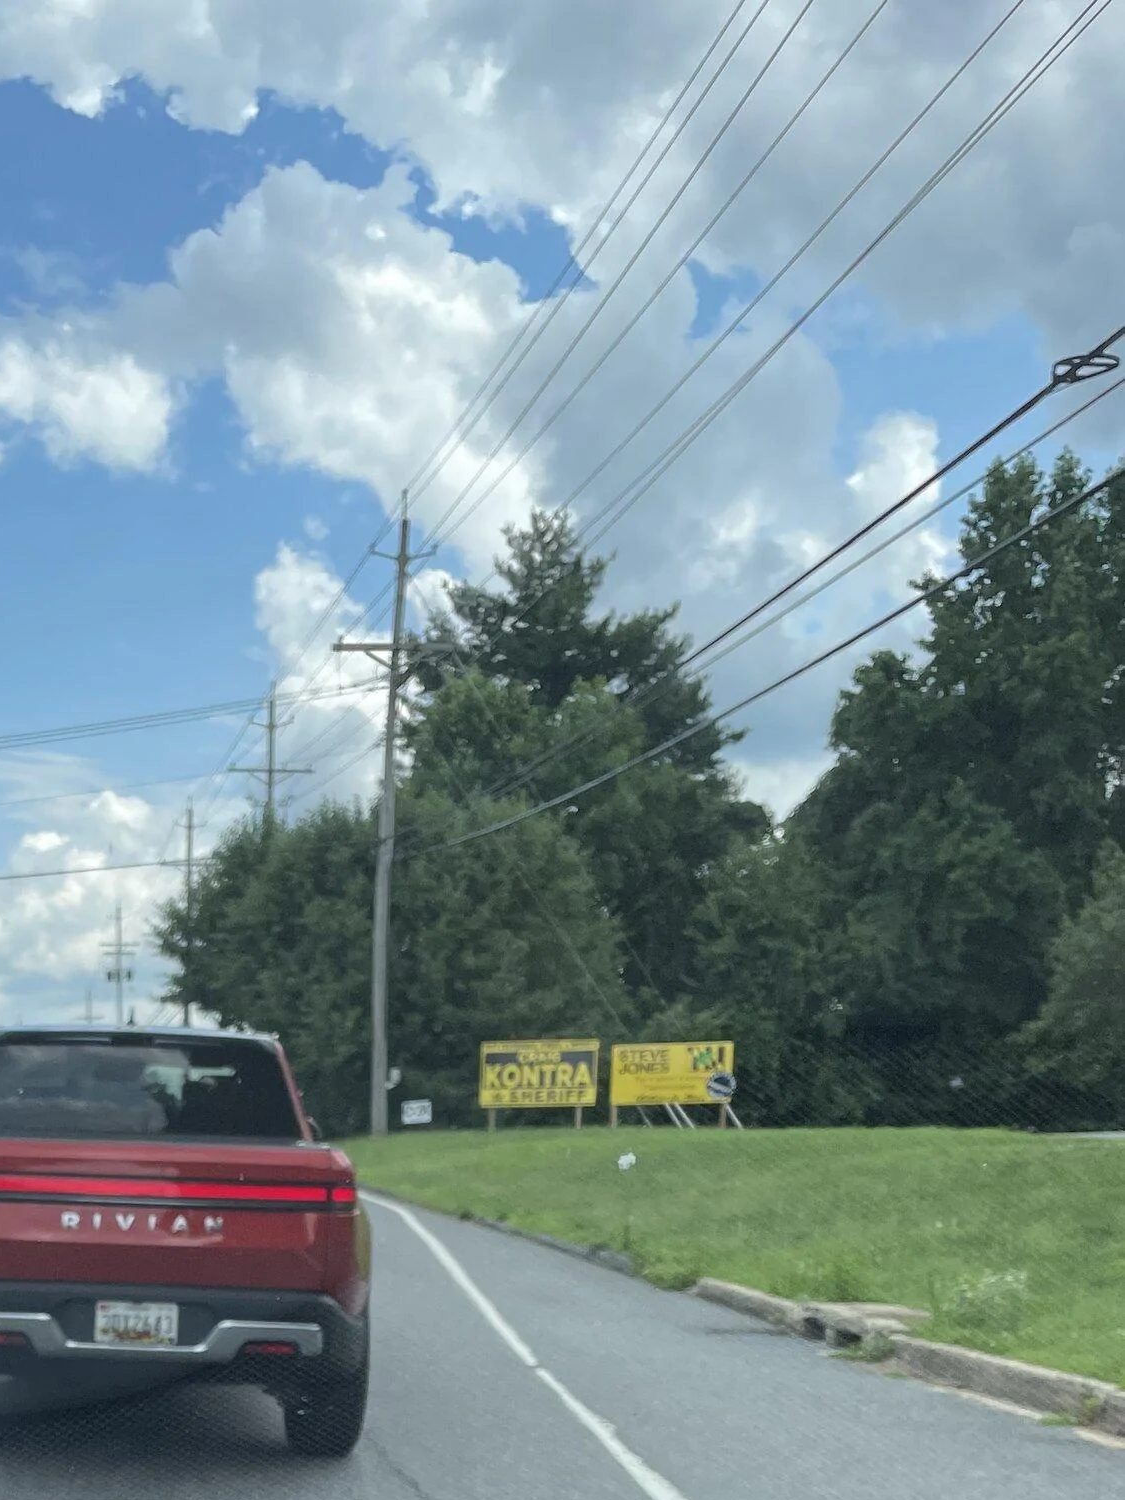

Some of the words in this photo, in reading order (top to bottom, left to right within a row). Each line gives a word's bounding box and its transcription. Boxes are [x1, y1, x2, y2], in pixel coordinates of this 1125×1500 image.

[619, 1049, 670, 1062] STEVE
[485, 1061, 592, 1089] KONTRA
[619, 1062, 670, 1074] JONES
[510, 1089, 587, 1103] SHERIFF
[61, 1210, 224, 1234] RIVIAN
